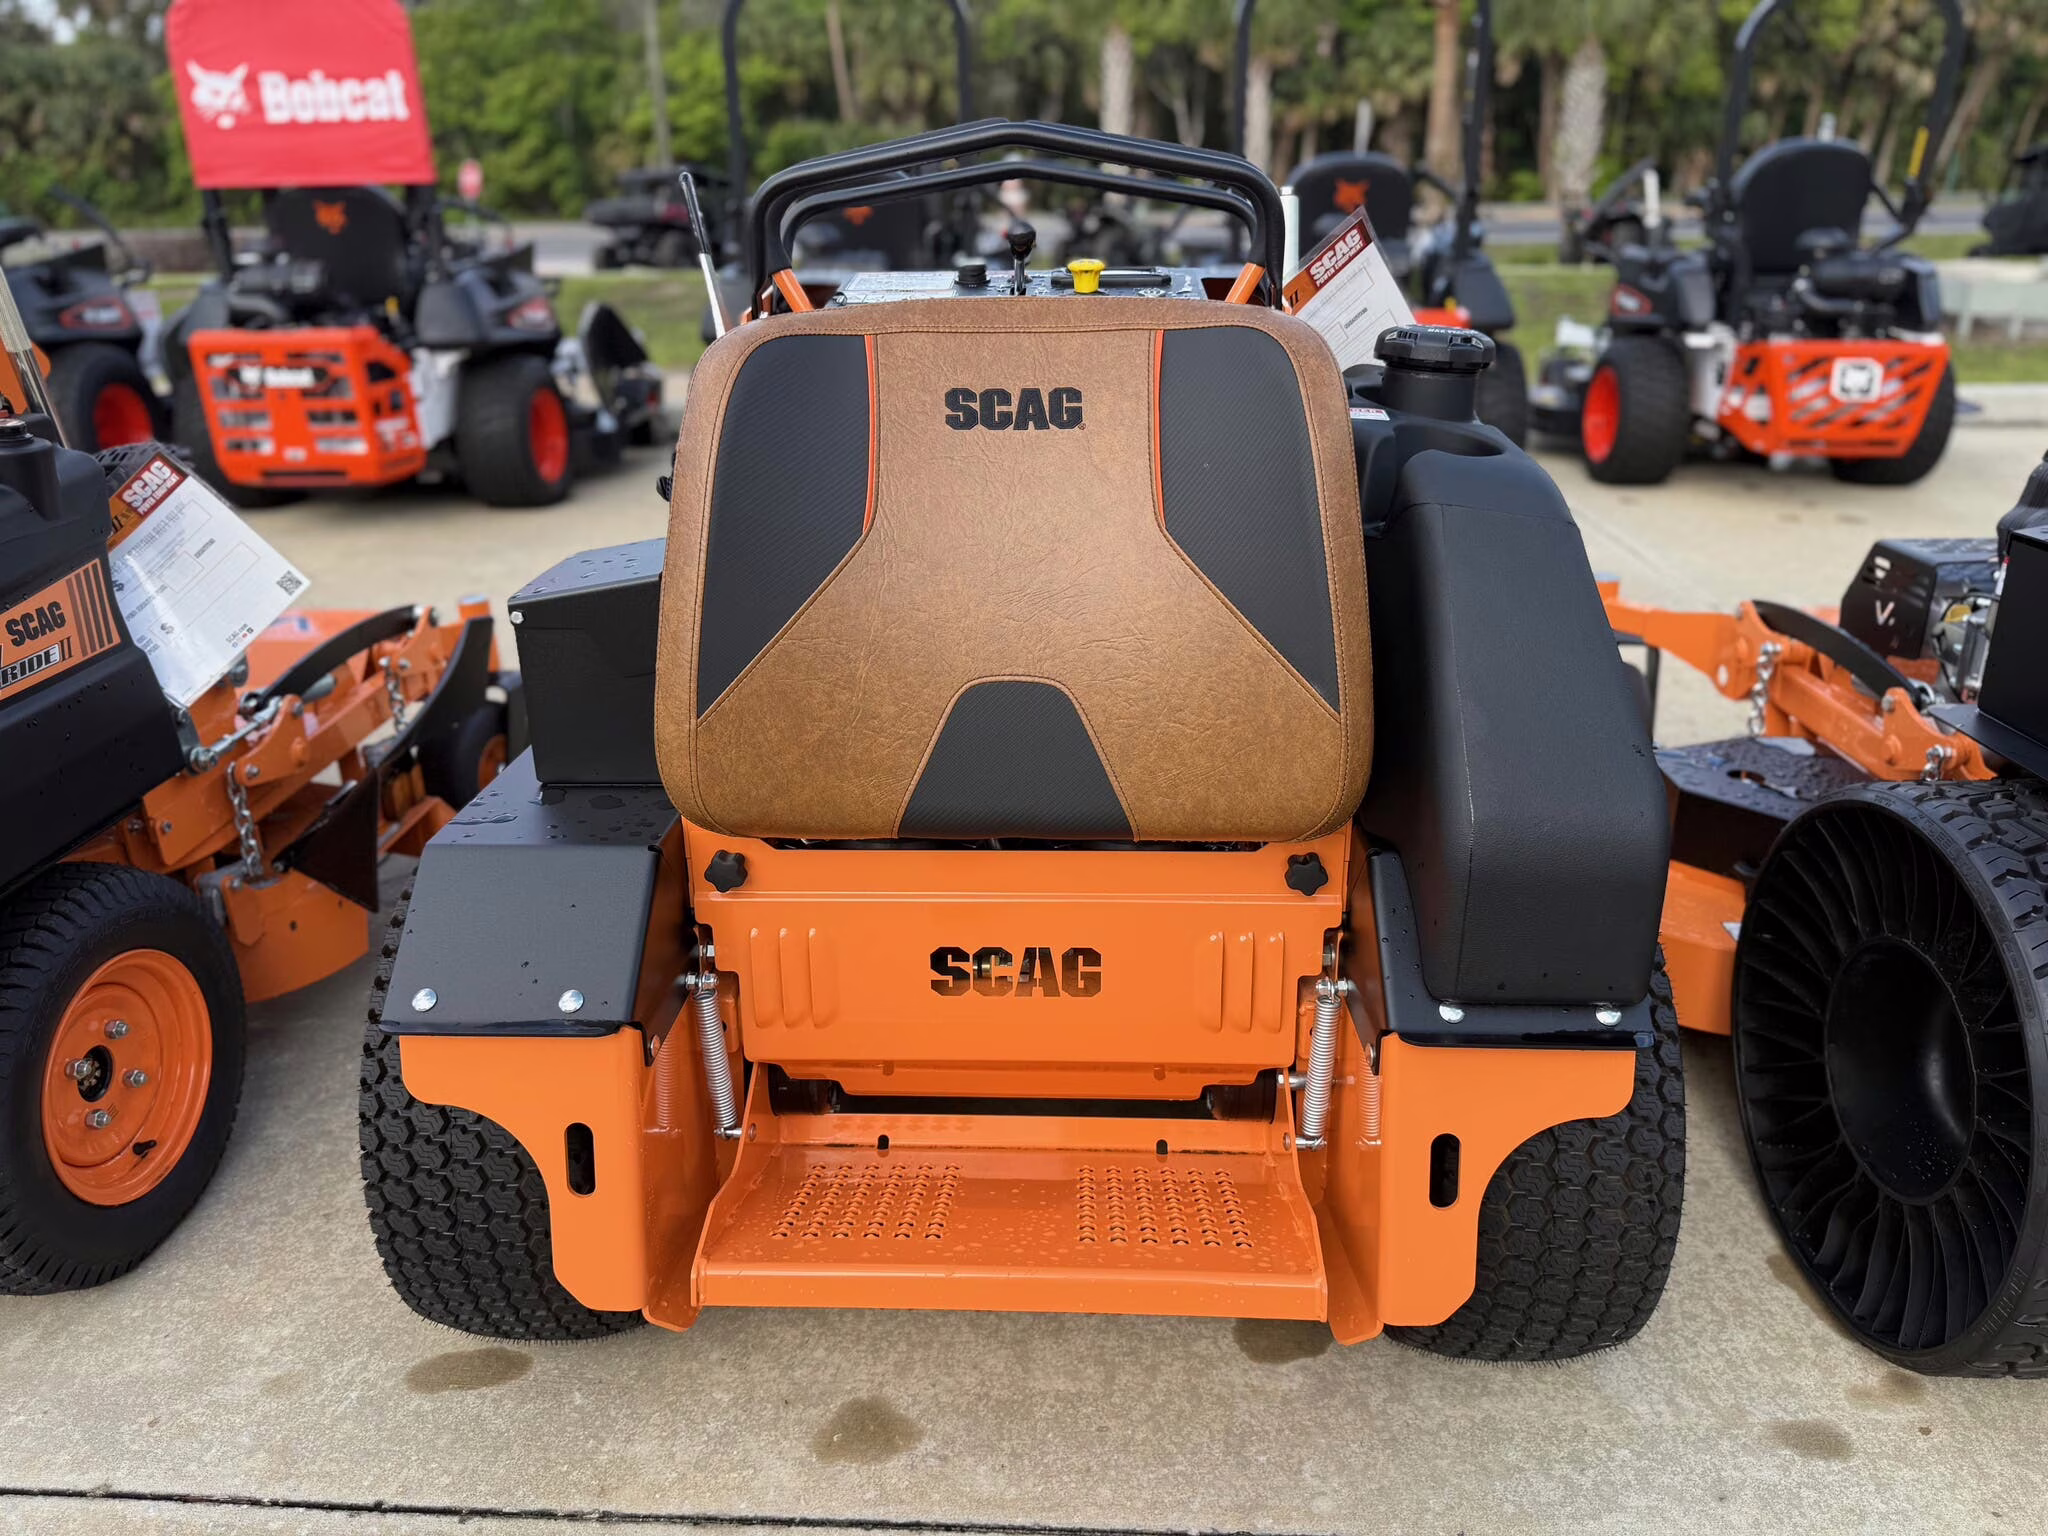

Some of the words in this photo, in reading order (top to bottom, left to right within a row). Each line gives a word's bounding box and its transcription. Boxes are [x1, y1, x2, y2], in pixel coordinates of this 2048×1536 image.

[257, 69, 410, 124] Bobcat
[1309, 228, 1361, 281] SCAG
[944, 386, 1084, 431] SCAG
[122, 460, 171, 508] SCAG
[5, 601, 66, 647] SCAG
[930, 946, 1101, 997] SCAG
